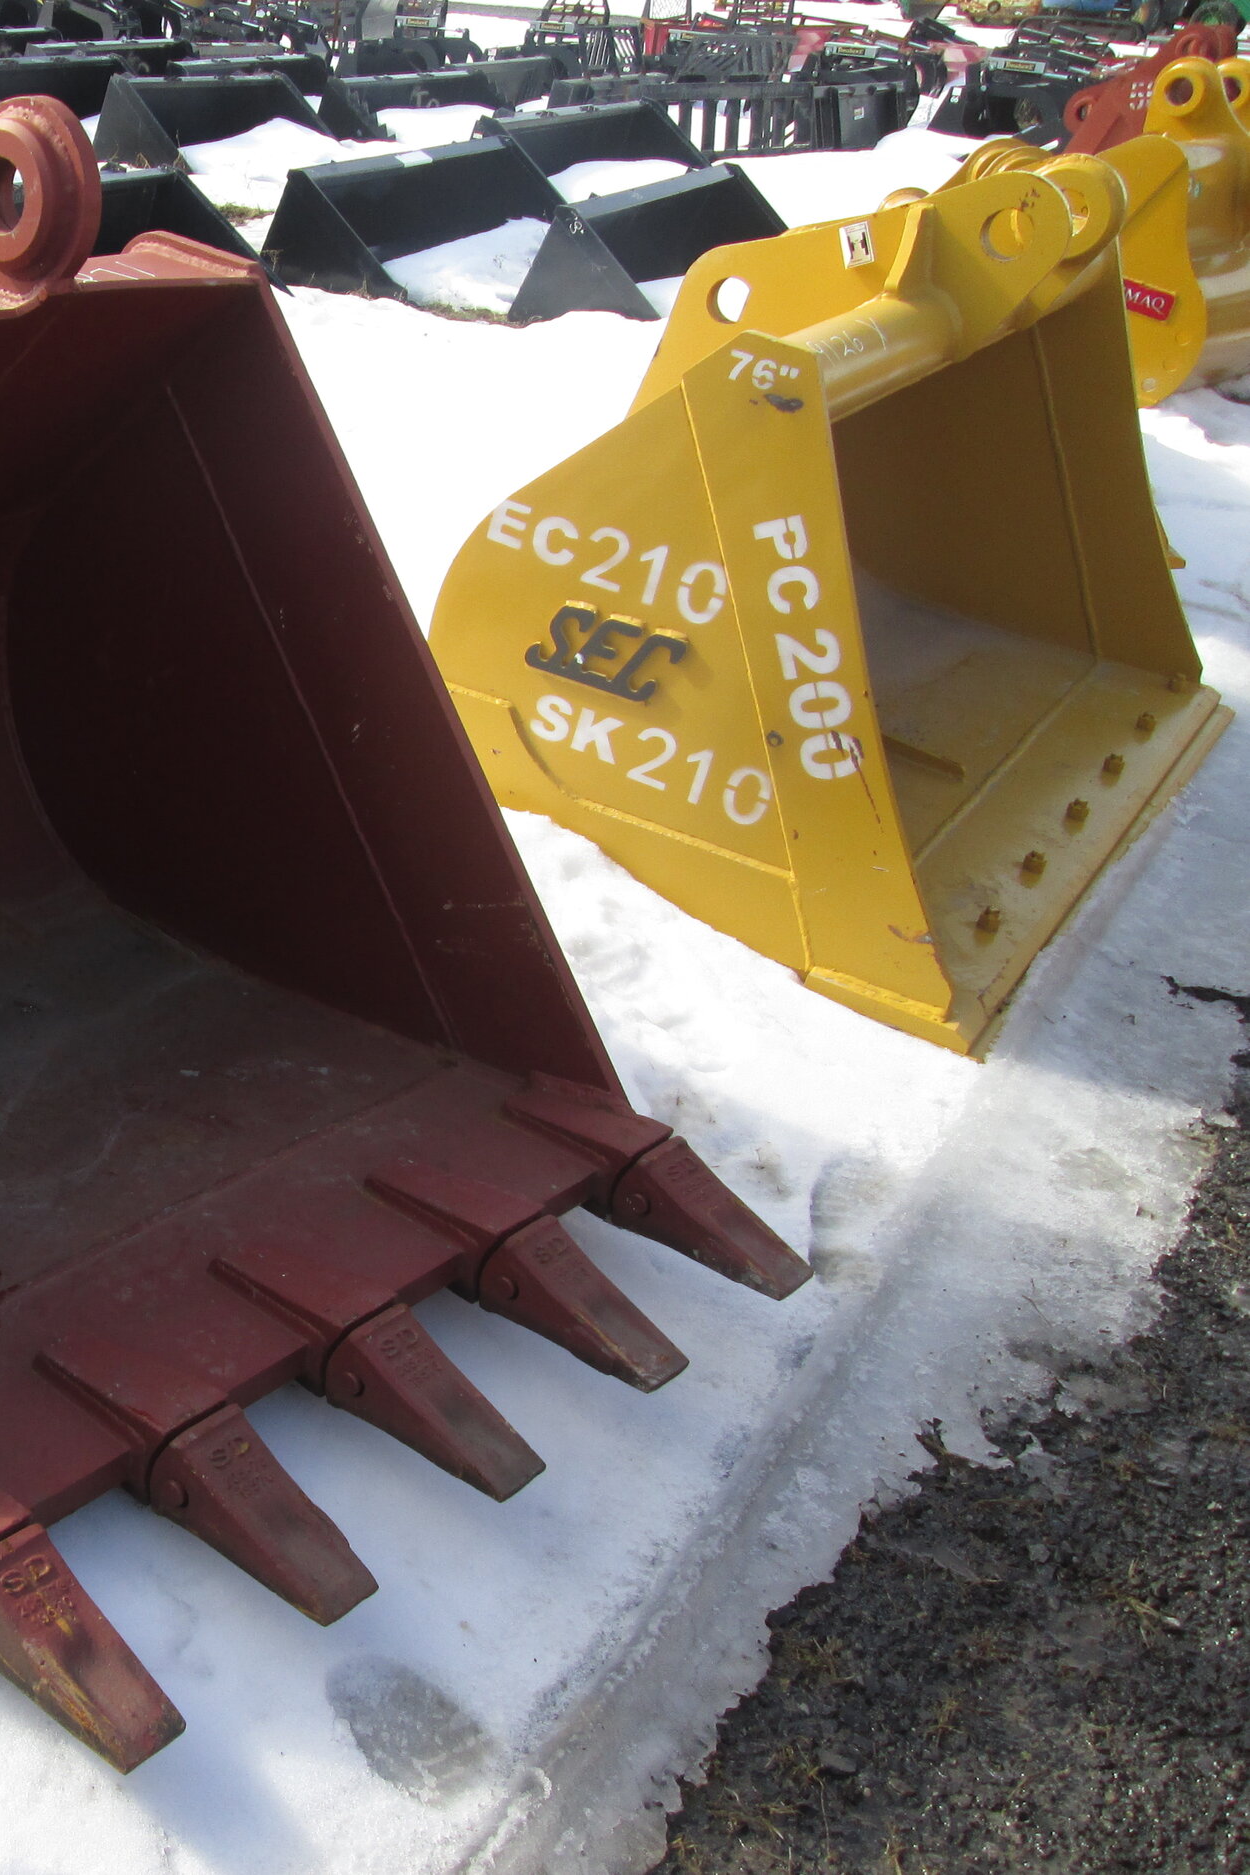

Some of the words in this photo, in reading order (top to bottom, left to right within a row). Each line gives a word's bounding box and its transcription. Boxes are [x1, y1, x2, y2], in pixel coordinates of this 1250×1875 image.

[728, 349, 800, 390] 76"
[487, 500, 728, 625] EC210
[524, 599, 690, 703] SEC
[753, 514, 865, 781] PC200
[529, 694, 772, 826] SK210
